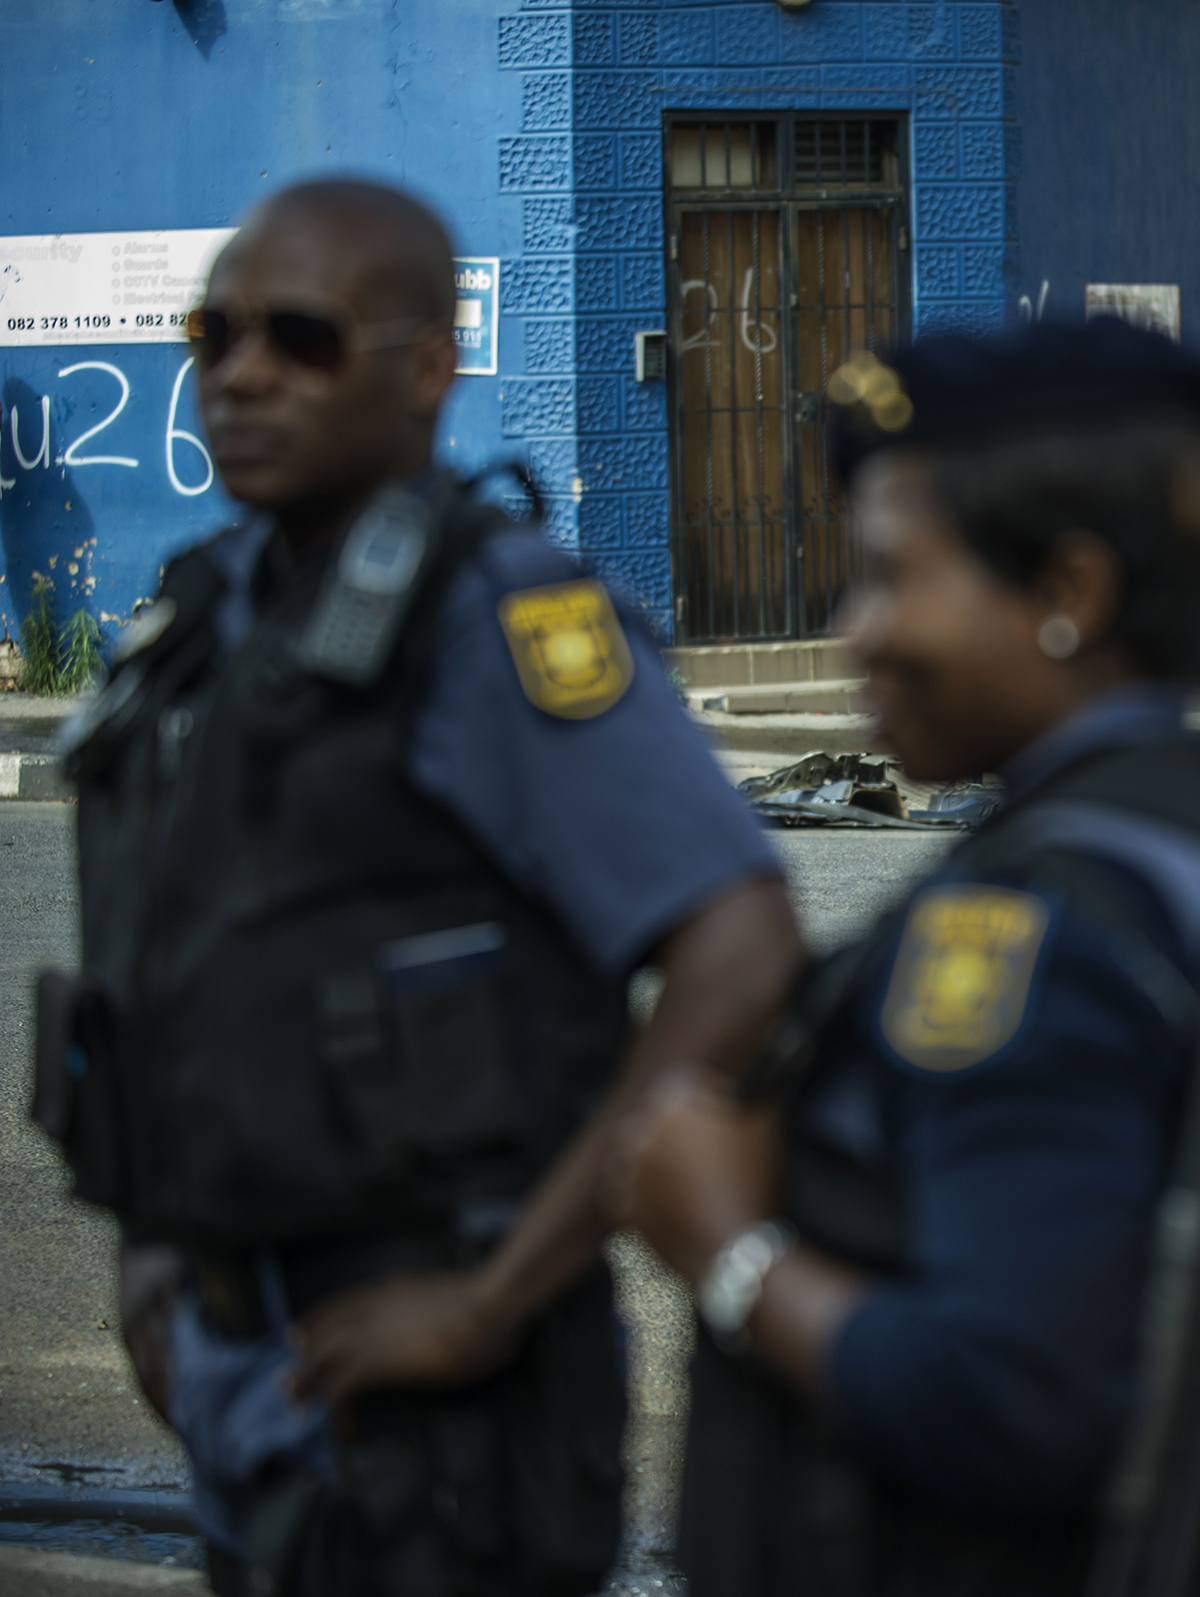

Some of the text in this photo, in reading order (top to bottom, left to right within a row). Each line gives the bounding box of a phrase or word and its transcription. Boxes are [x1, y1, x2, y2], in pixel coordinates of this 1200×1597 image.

[123, 274, 160, 288] CCTV
[454, 268, 491, 290] ubb
[680, 267, 777, 353] 26
[7, 314, 187, 331] 082 378 1109 082 82
